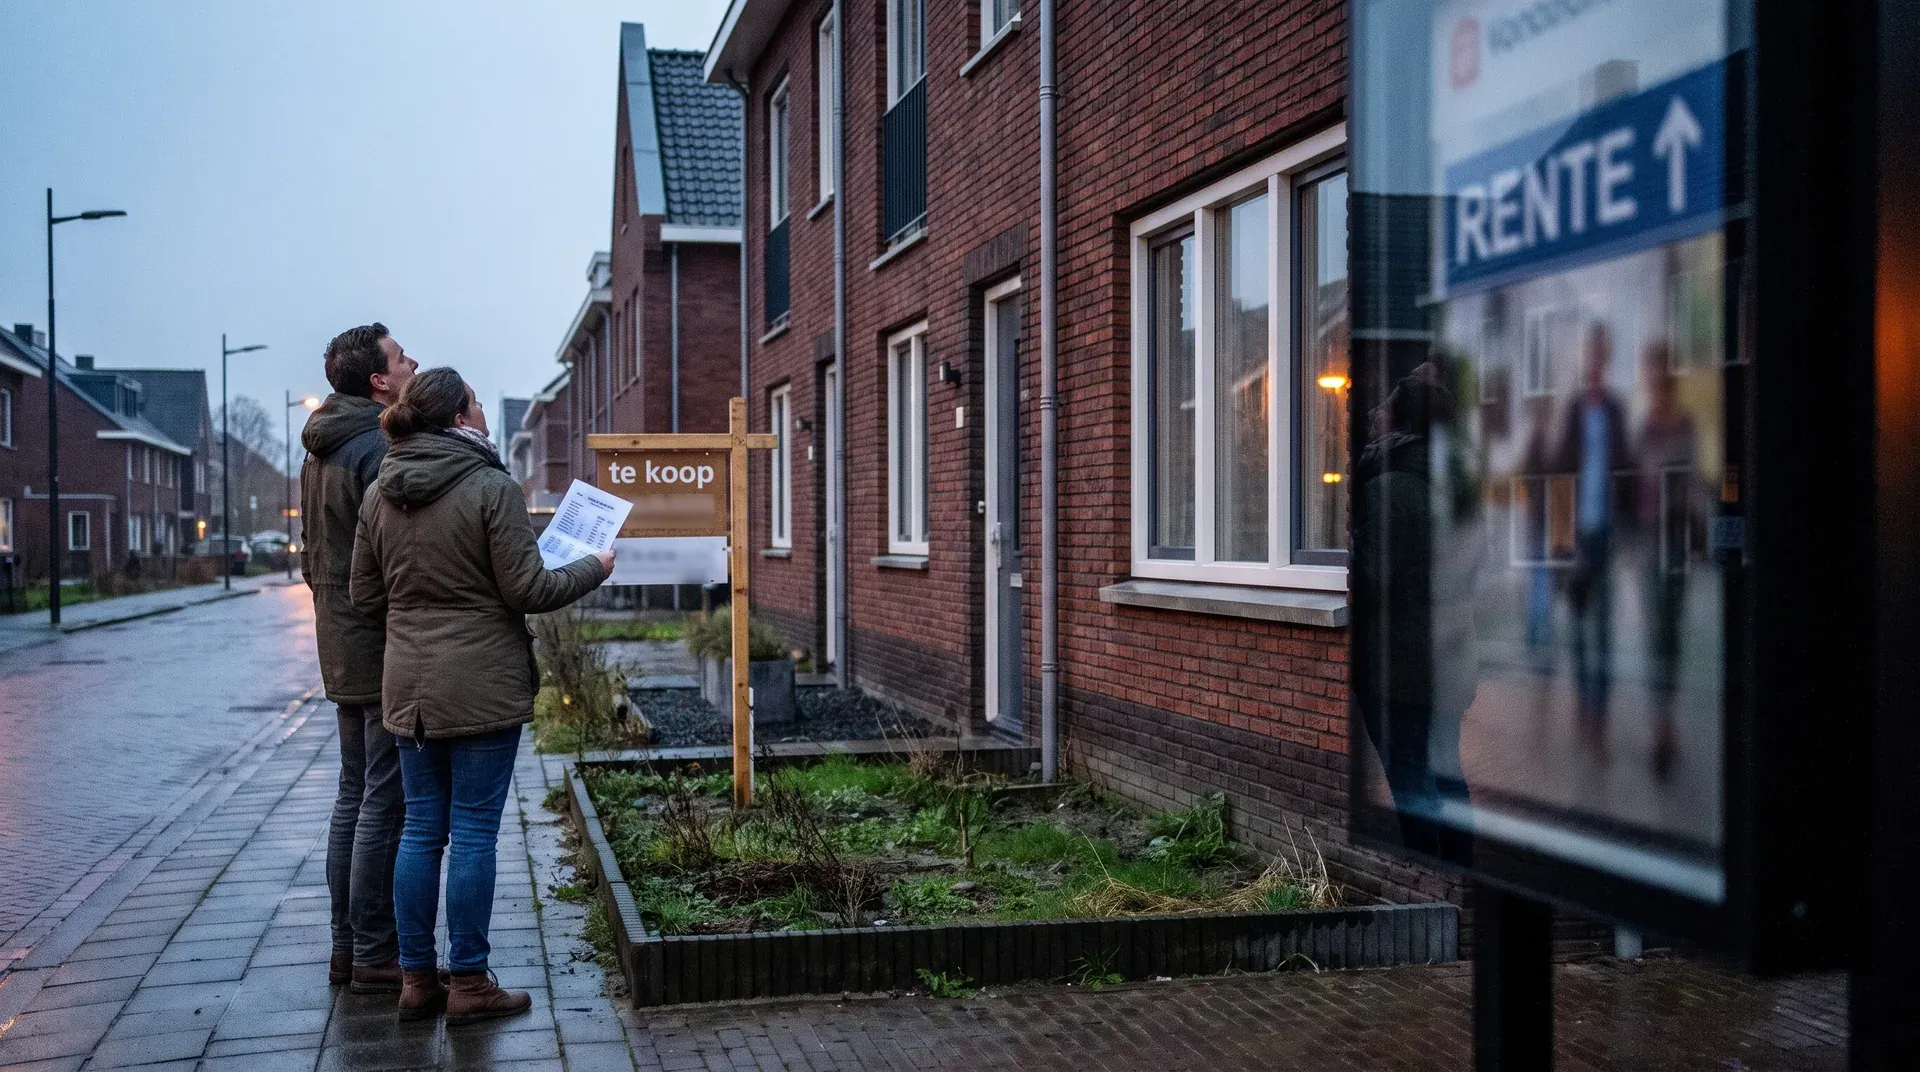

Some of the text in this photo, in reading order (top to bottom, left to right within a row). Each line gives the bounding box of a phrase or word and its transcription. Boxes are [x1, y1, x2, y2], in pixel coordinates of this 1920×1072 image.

[1455, 127, 1636, 266] RENTE
[608, 460, 714, 489] te koop
